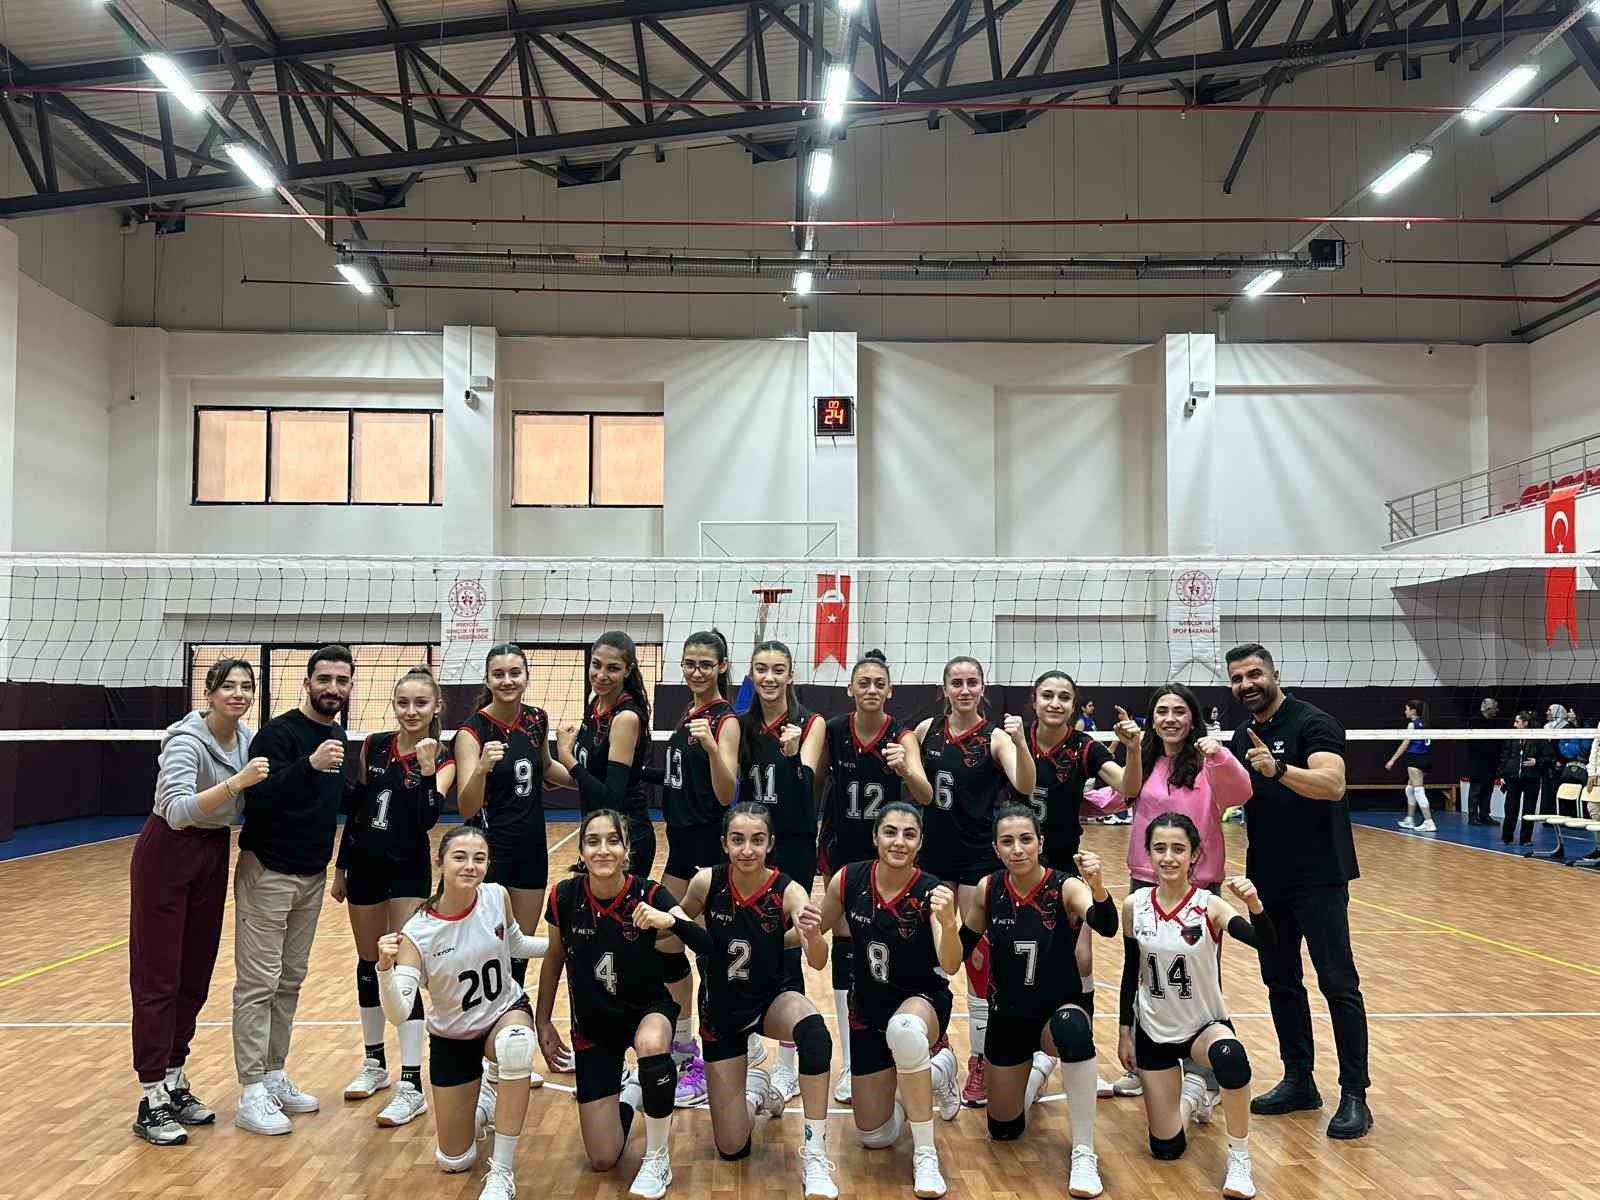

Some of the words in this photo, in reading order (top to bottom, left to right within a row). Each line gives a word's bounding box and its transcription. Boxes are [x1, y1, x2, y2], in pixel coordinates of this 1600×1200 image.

[824, 409, 845, 425] 24
[514, 758, 534, 797] 9
[664, 746, 682, 790] 13
[749, 763, 778, 804] 11
[371, 788, 392, 831] 1
[846, 781, 885, 820] 12
[935, 769, 955, 811] 6
[1029, 785, 1049, 822] 5
[593, 951, 618, 995] 4
[727, 938, 752, 981] 2
[867, 940, 890, 983] 8
[1013, 940, 1038, 986] 7
[1147, 952, 1192, 1000] 14
[457, 958, 503, 1012] 20
